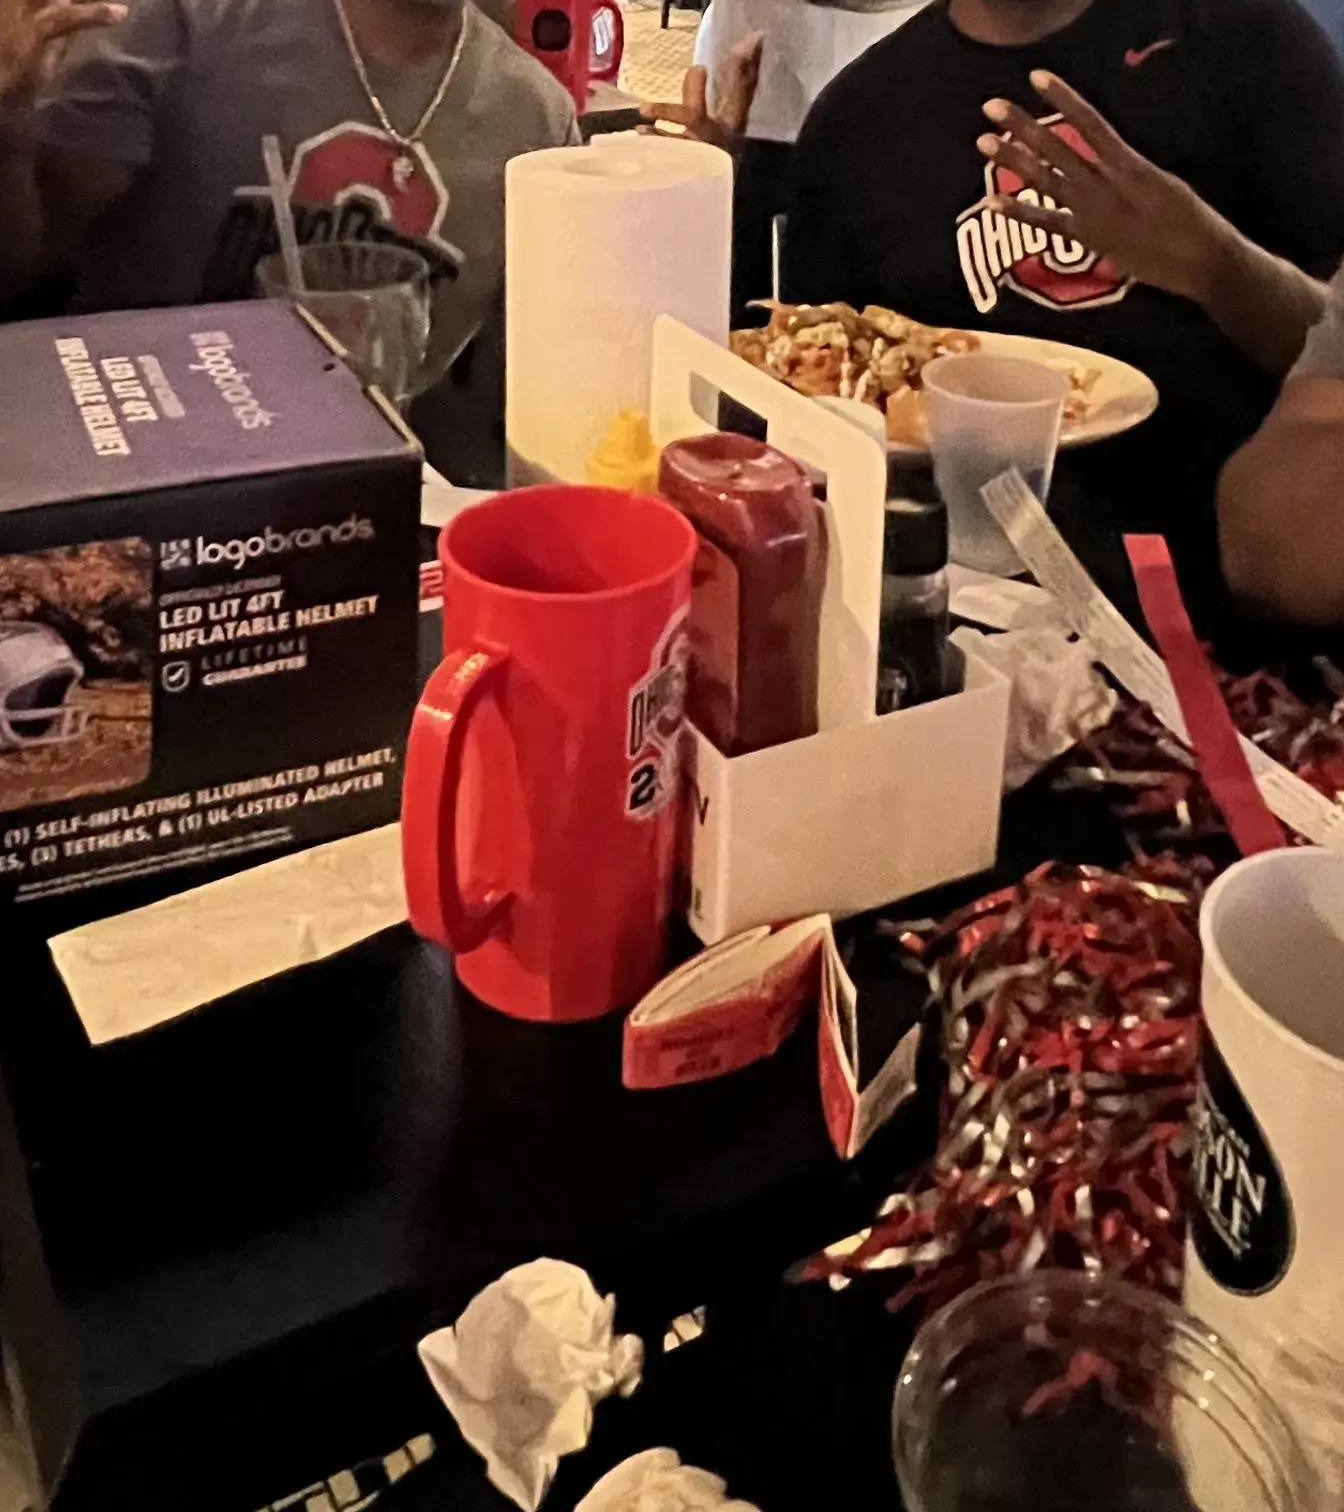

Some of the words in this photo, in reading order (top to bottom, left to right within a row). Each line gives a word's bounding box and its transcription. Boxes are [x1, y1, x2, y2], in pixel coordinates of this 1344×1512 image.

[54, 337, 108, 406] INFLATABLE
[100, 356, 136, 380] LED
[111, 379, 147, 400] LIT
[189, 343, 283, 430] logobrands
[80, 402, 132, 456] HELMET
[196, 513, 377, 570] logobrands
[159, 611, 291, 653] INFLATABLE
[295, 594, 380, 628] HELMET
[160, 605, 202, 630] LED
[208, 597, 242, 621] LIT
[246, 589, 286, 614] 4FT
[3, 826, 31, 849] (1)
[34, 791, 192, 841] SELF-INFLATING
[196, 764, 320, 805] ILLUMINATED
[324, 747, 397, 777] HELMET,
[63, 824, 153, 858] TETHERS,
[158, 819, 174, 838] &
[178, 812, 203, 835] (1)
[207, 791, 299, 826] UL-LISTED
[303, 771, 385, 805] ADAPTER
